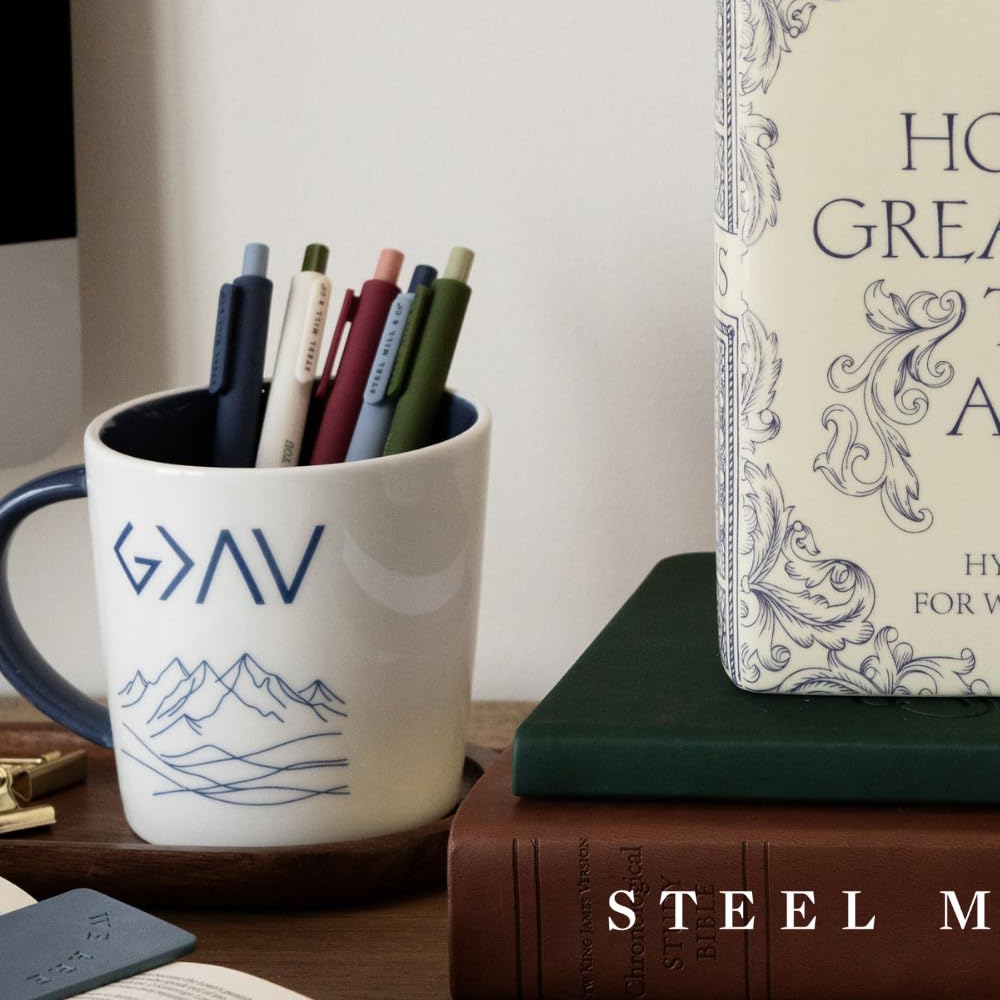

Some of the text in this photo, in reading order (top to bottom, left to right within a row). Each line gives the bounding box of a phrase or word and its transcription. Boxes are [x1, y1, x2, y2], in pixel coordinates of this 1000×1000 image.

[914, 592, 975, 615] FOR
[577, 838, 591, 895] VERSION
[579, 898, 595, 934] JAMES
[694, 883, 717, 961] BIBLE
[580, 939, 593, 973] KING
